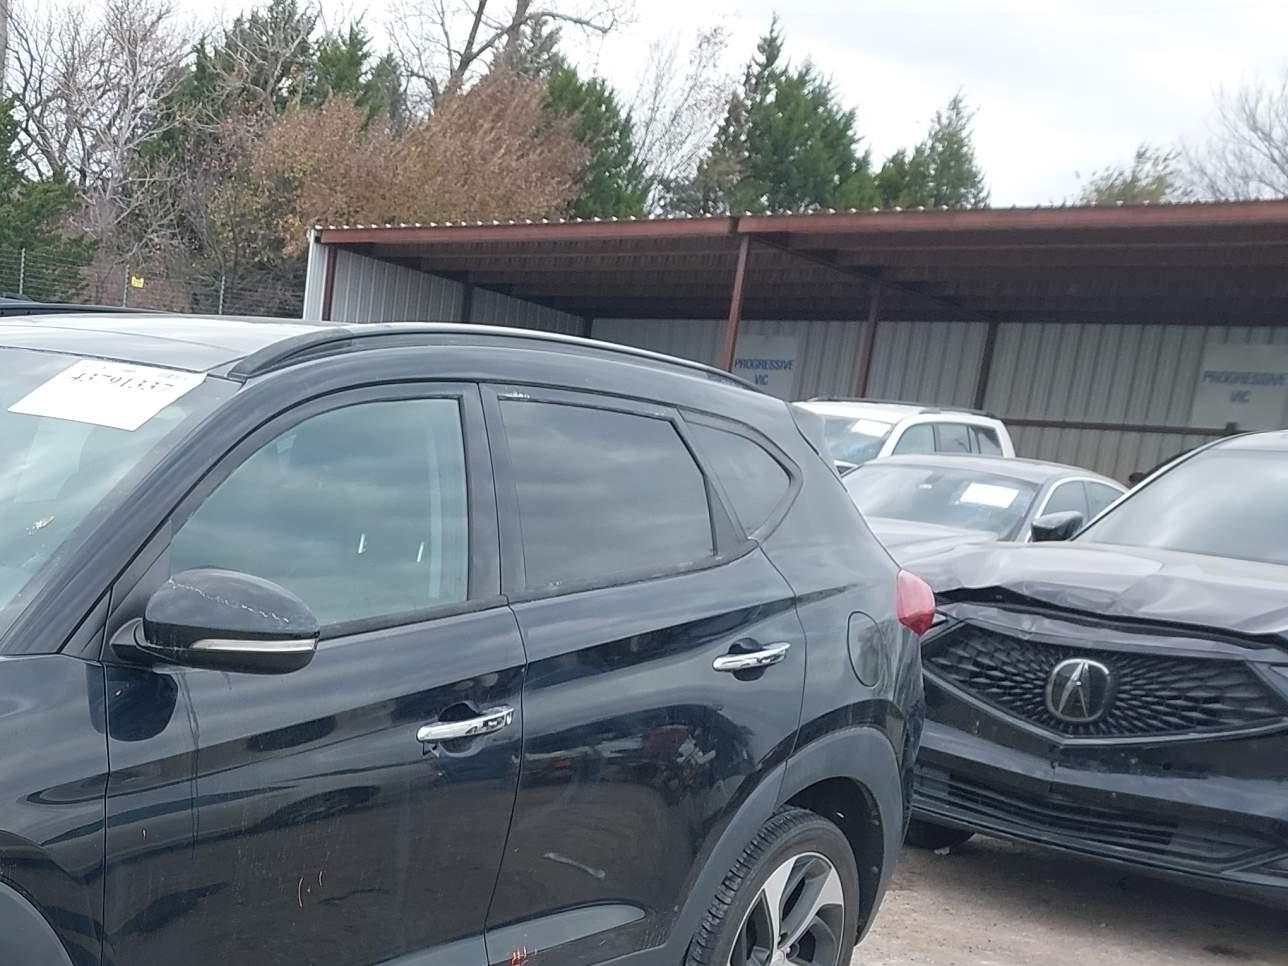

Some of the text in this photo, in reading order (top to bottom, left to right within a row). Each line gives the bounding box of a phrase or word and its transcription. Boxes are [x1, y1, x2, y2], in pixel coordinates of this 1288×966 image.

[734, 358, 794, 370] PROGRESSIVE
[754, 374, 769, 385] VIC
[1202, 370, 1288, 385] PROGRESSIVE
